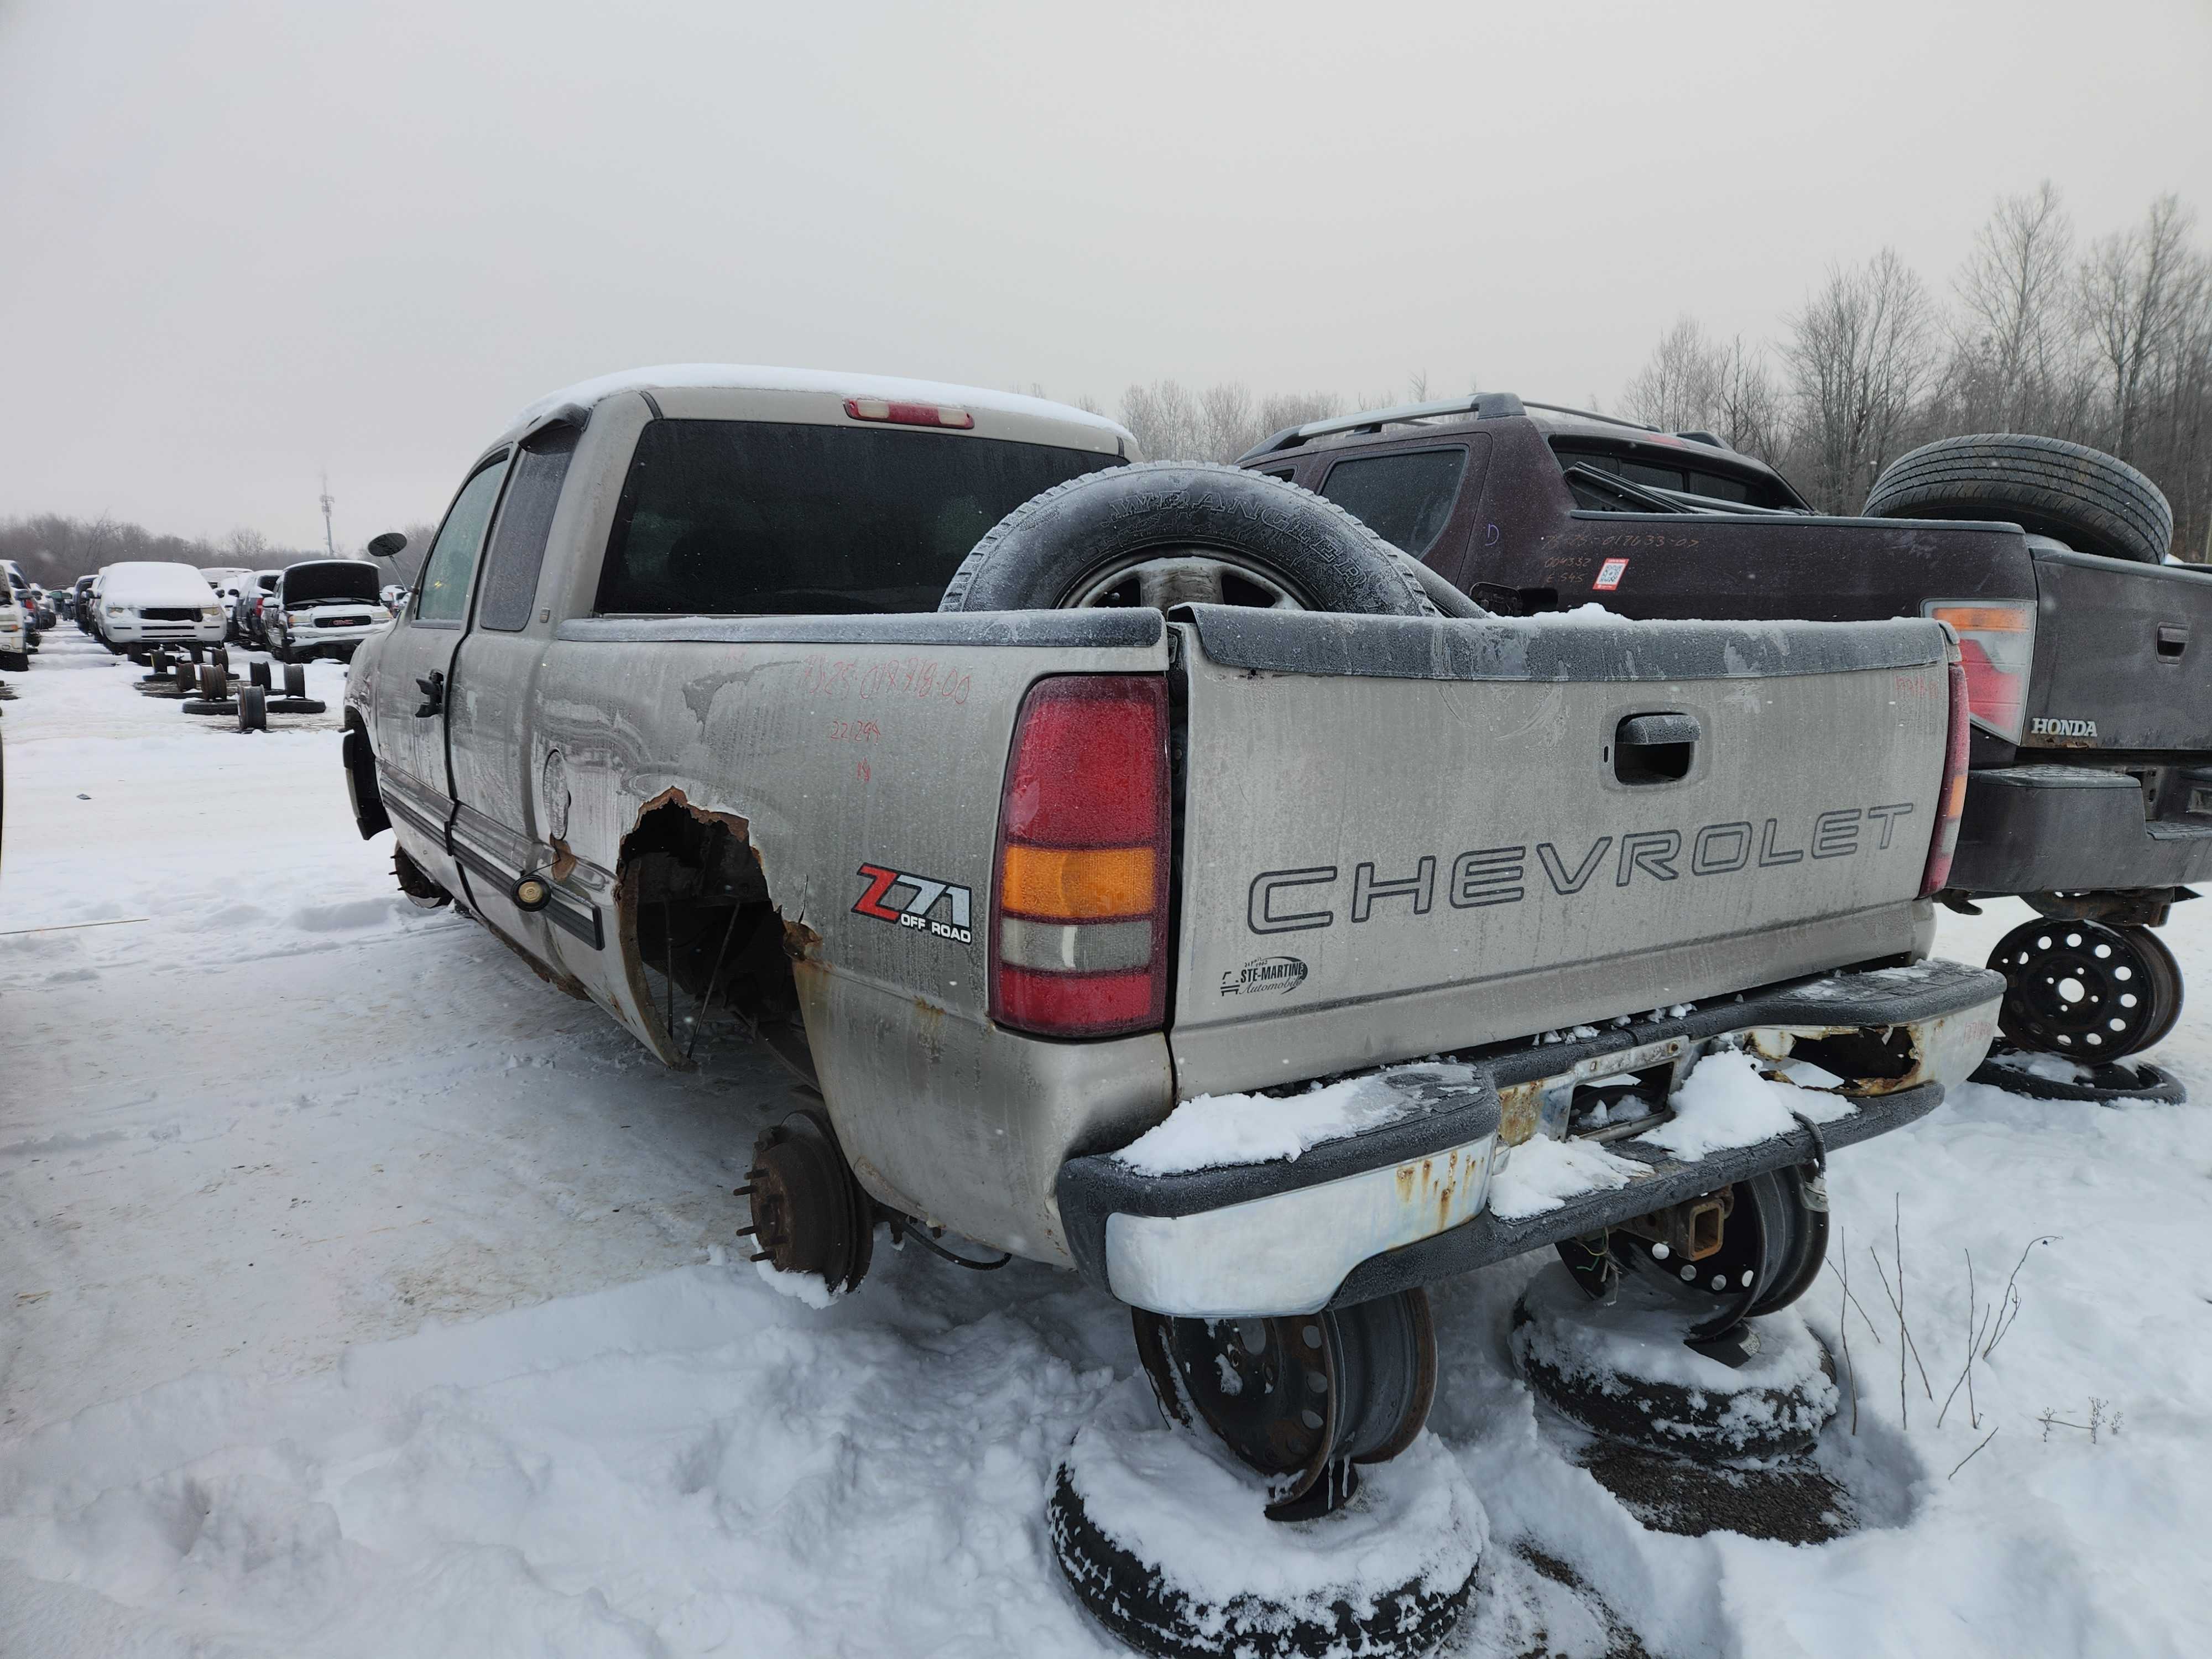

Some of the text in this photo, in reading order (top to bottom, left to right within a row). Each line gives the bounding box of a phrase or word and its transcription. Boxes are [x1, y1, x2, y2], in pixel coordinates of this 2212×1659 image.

[1108, 490, 1368, 588] WRANGLER
[2031, 718, 2098, 737] HONDA
[852, 863, 972, 929] Z71
[1248, 803, 1914, 935] CHEVROLET
[900, 913, 971, 943] OFF ROAD
